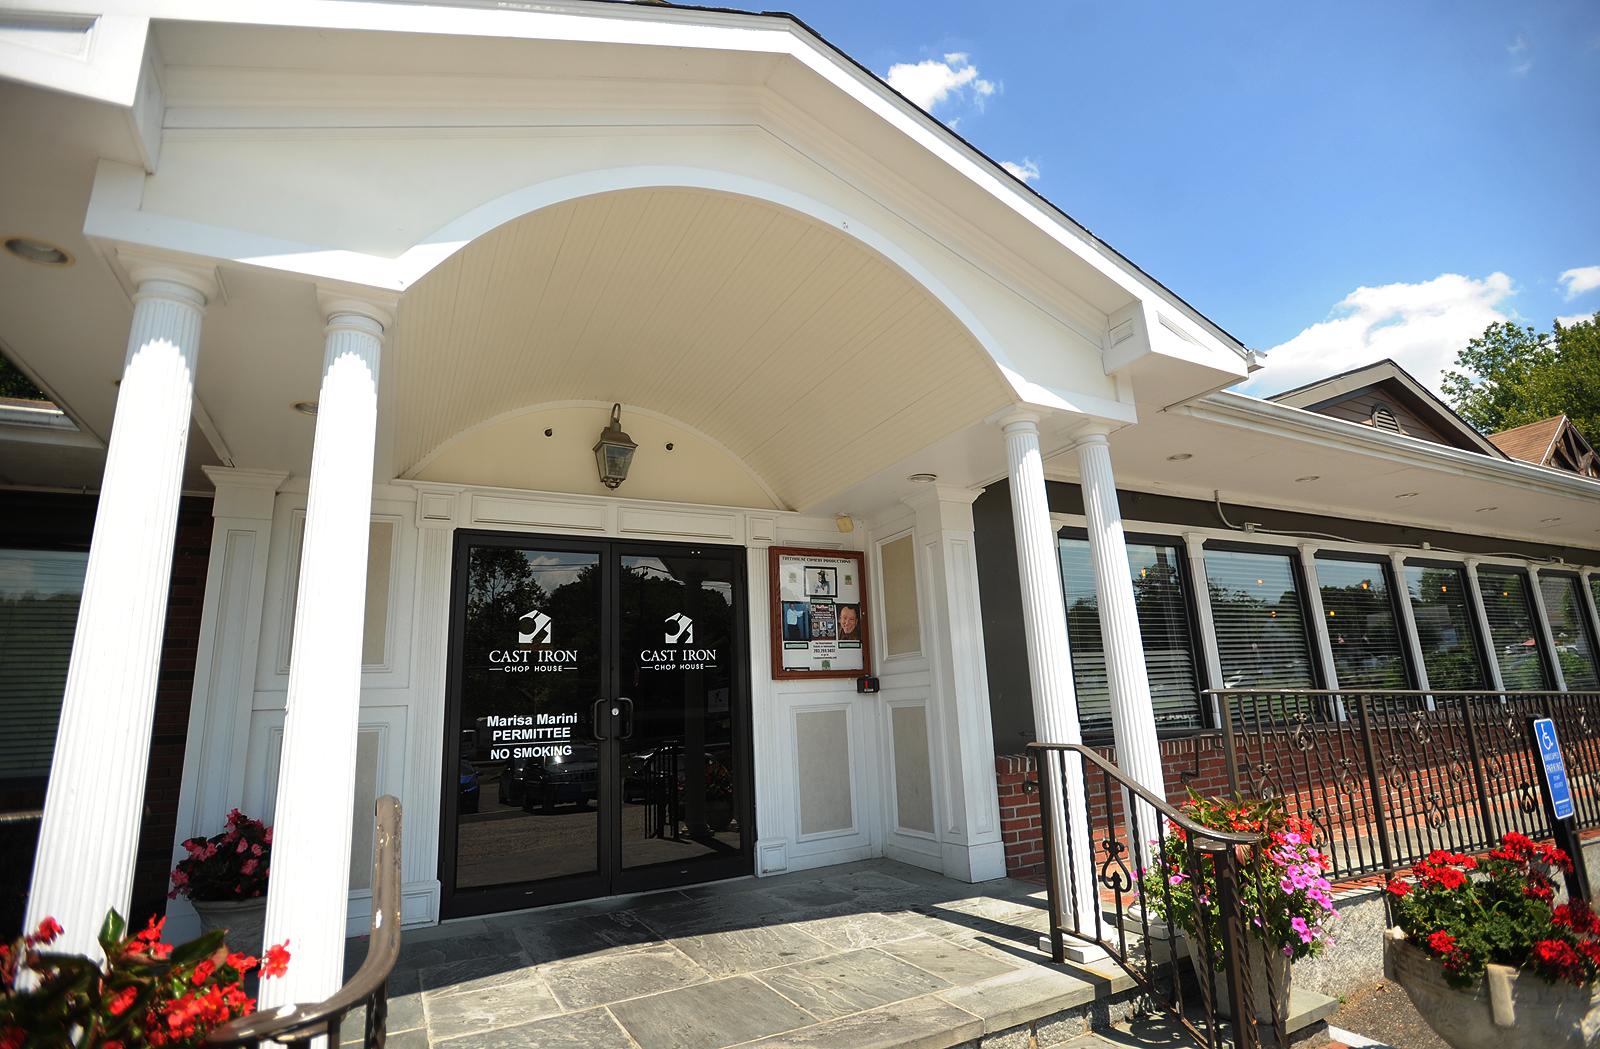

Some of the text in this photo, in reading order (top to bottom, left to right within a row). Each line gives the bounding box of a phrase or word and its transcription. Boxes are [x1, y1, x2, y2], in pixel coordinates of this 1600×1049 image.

[489, 650, 578, 663] CAST IRON
[641, 650, 716, 661] CAST IRON
[504, 665, 530, 673] CHOP
[487, 713, 577, 727] Marisa Marini
[493, 727, 571, 741] PERMITTEE
[490, 745, 572, 760] NO SMOKING
